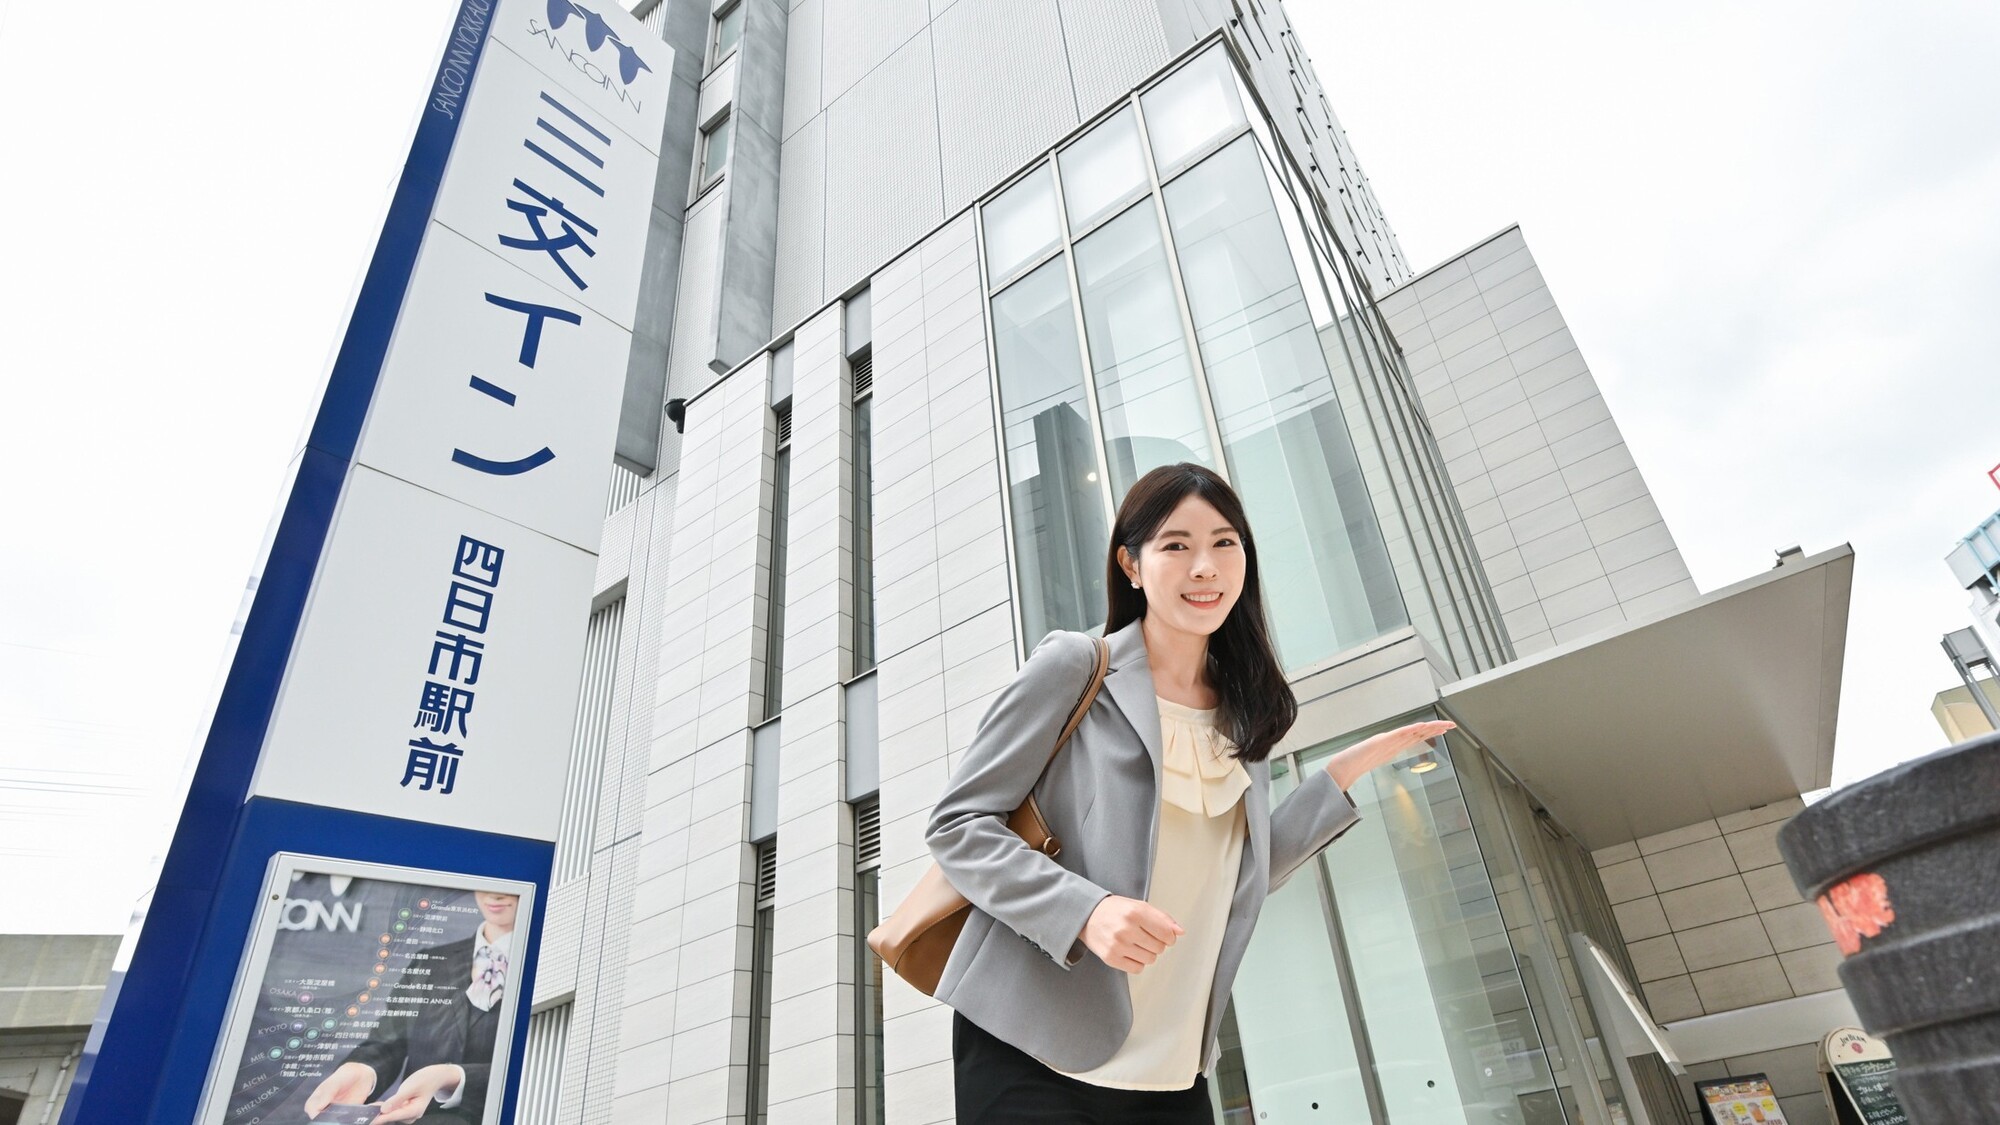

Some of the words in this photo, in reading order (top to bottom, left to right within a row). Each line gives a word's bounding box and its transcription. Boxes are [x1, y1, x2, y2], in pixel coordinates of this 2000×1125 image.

[451, 90, 612, 477] 三交イン
[399, 534, 505, 795] 四日市駅前
[269, 987, 297, 997] OSAKA
[258, 1023, 288, 1035] KYOTO
[250, 1052, 266, 1063] MIE
[242, 1073, 268, 1090] AICHI
[236, 1086, 280, 1115] SHIZUOKA
